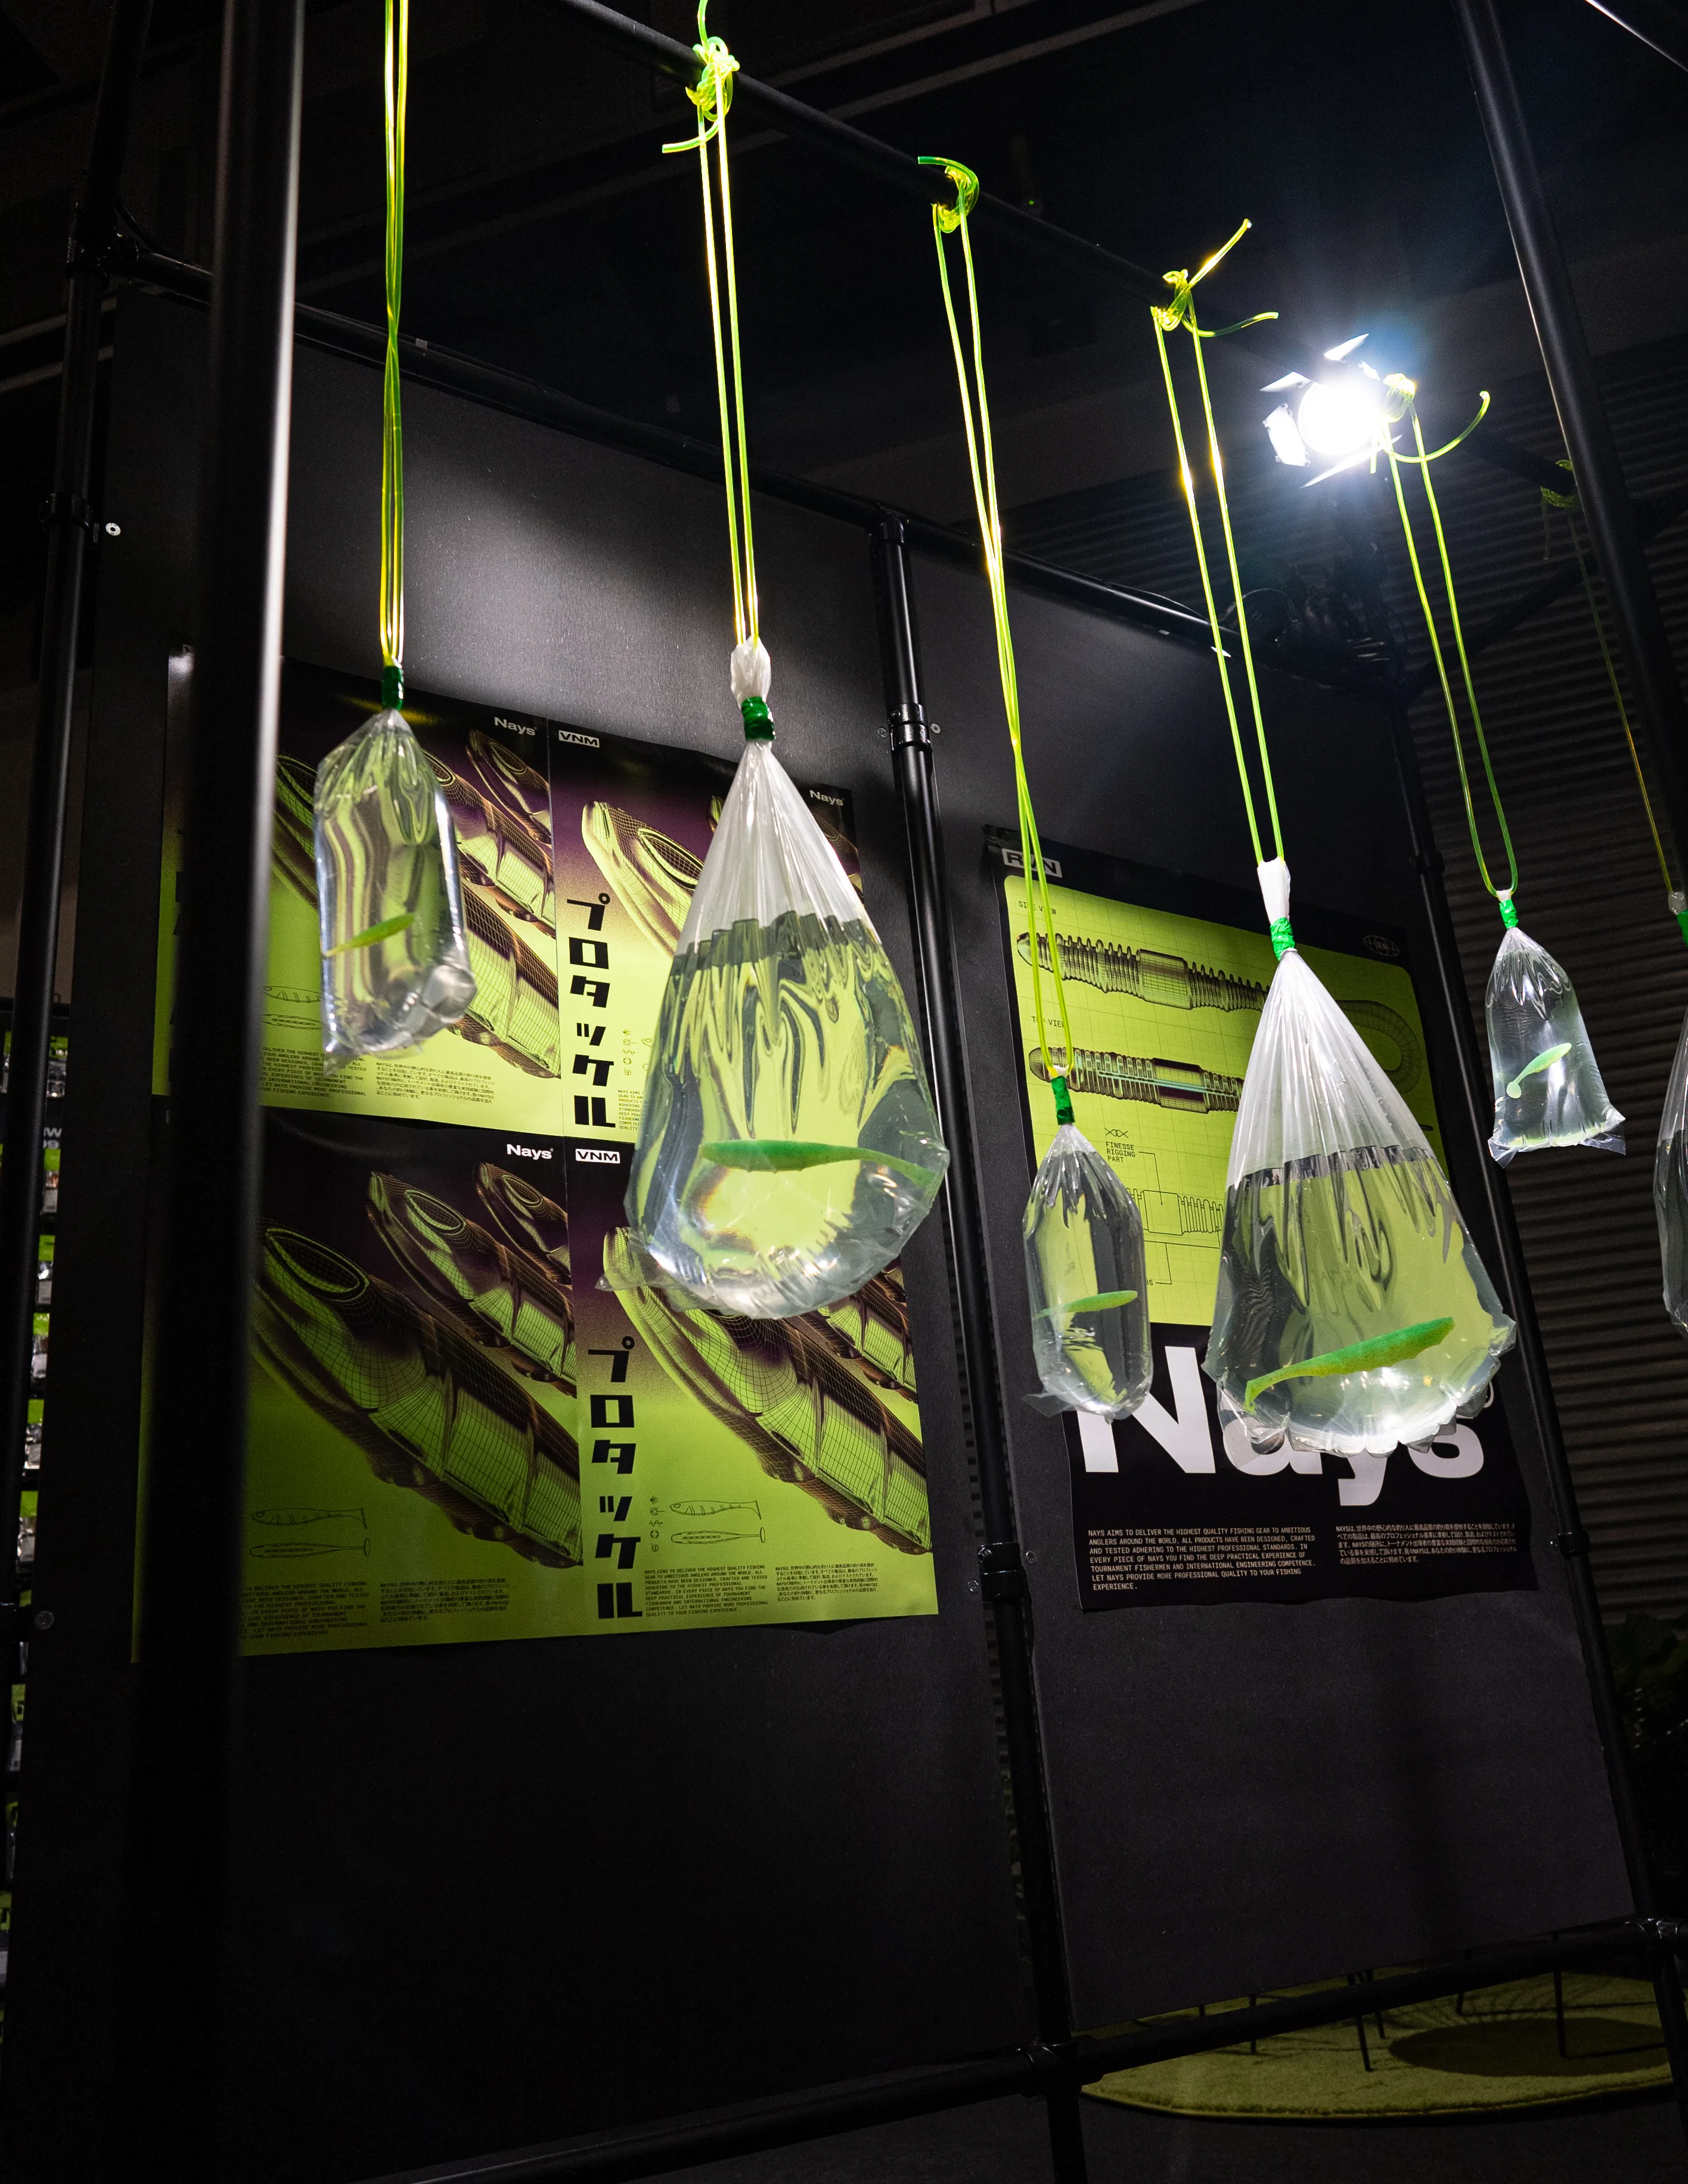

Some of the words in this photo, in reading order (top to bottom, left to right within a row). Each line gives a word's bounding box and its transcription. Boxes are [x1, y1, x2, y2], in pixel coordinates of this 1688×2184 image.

[494, 717, 535, 735] Nays
[559, 731, 598, 747] VNM
[809, 790, 843, 806] Nays
[1006, 852, 1057, 874] RN
[1018, 900, 1036, 911] SIE
[1047, 1018, 1065, 1028] VIE
[507, 1144, 552, 1160] Nays
[1106, 1141, 1135, 1151] FINESSE
[1106, 1148, 1135, 1157] RIGGING
[577, 1151, 618, 1161] VNM
